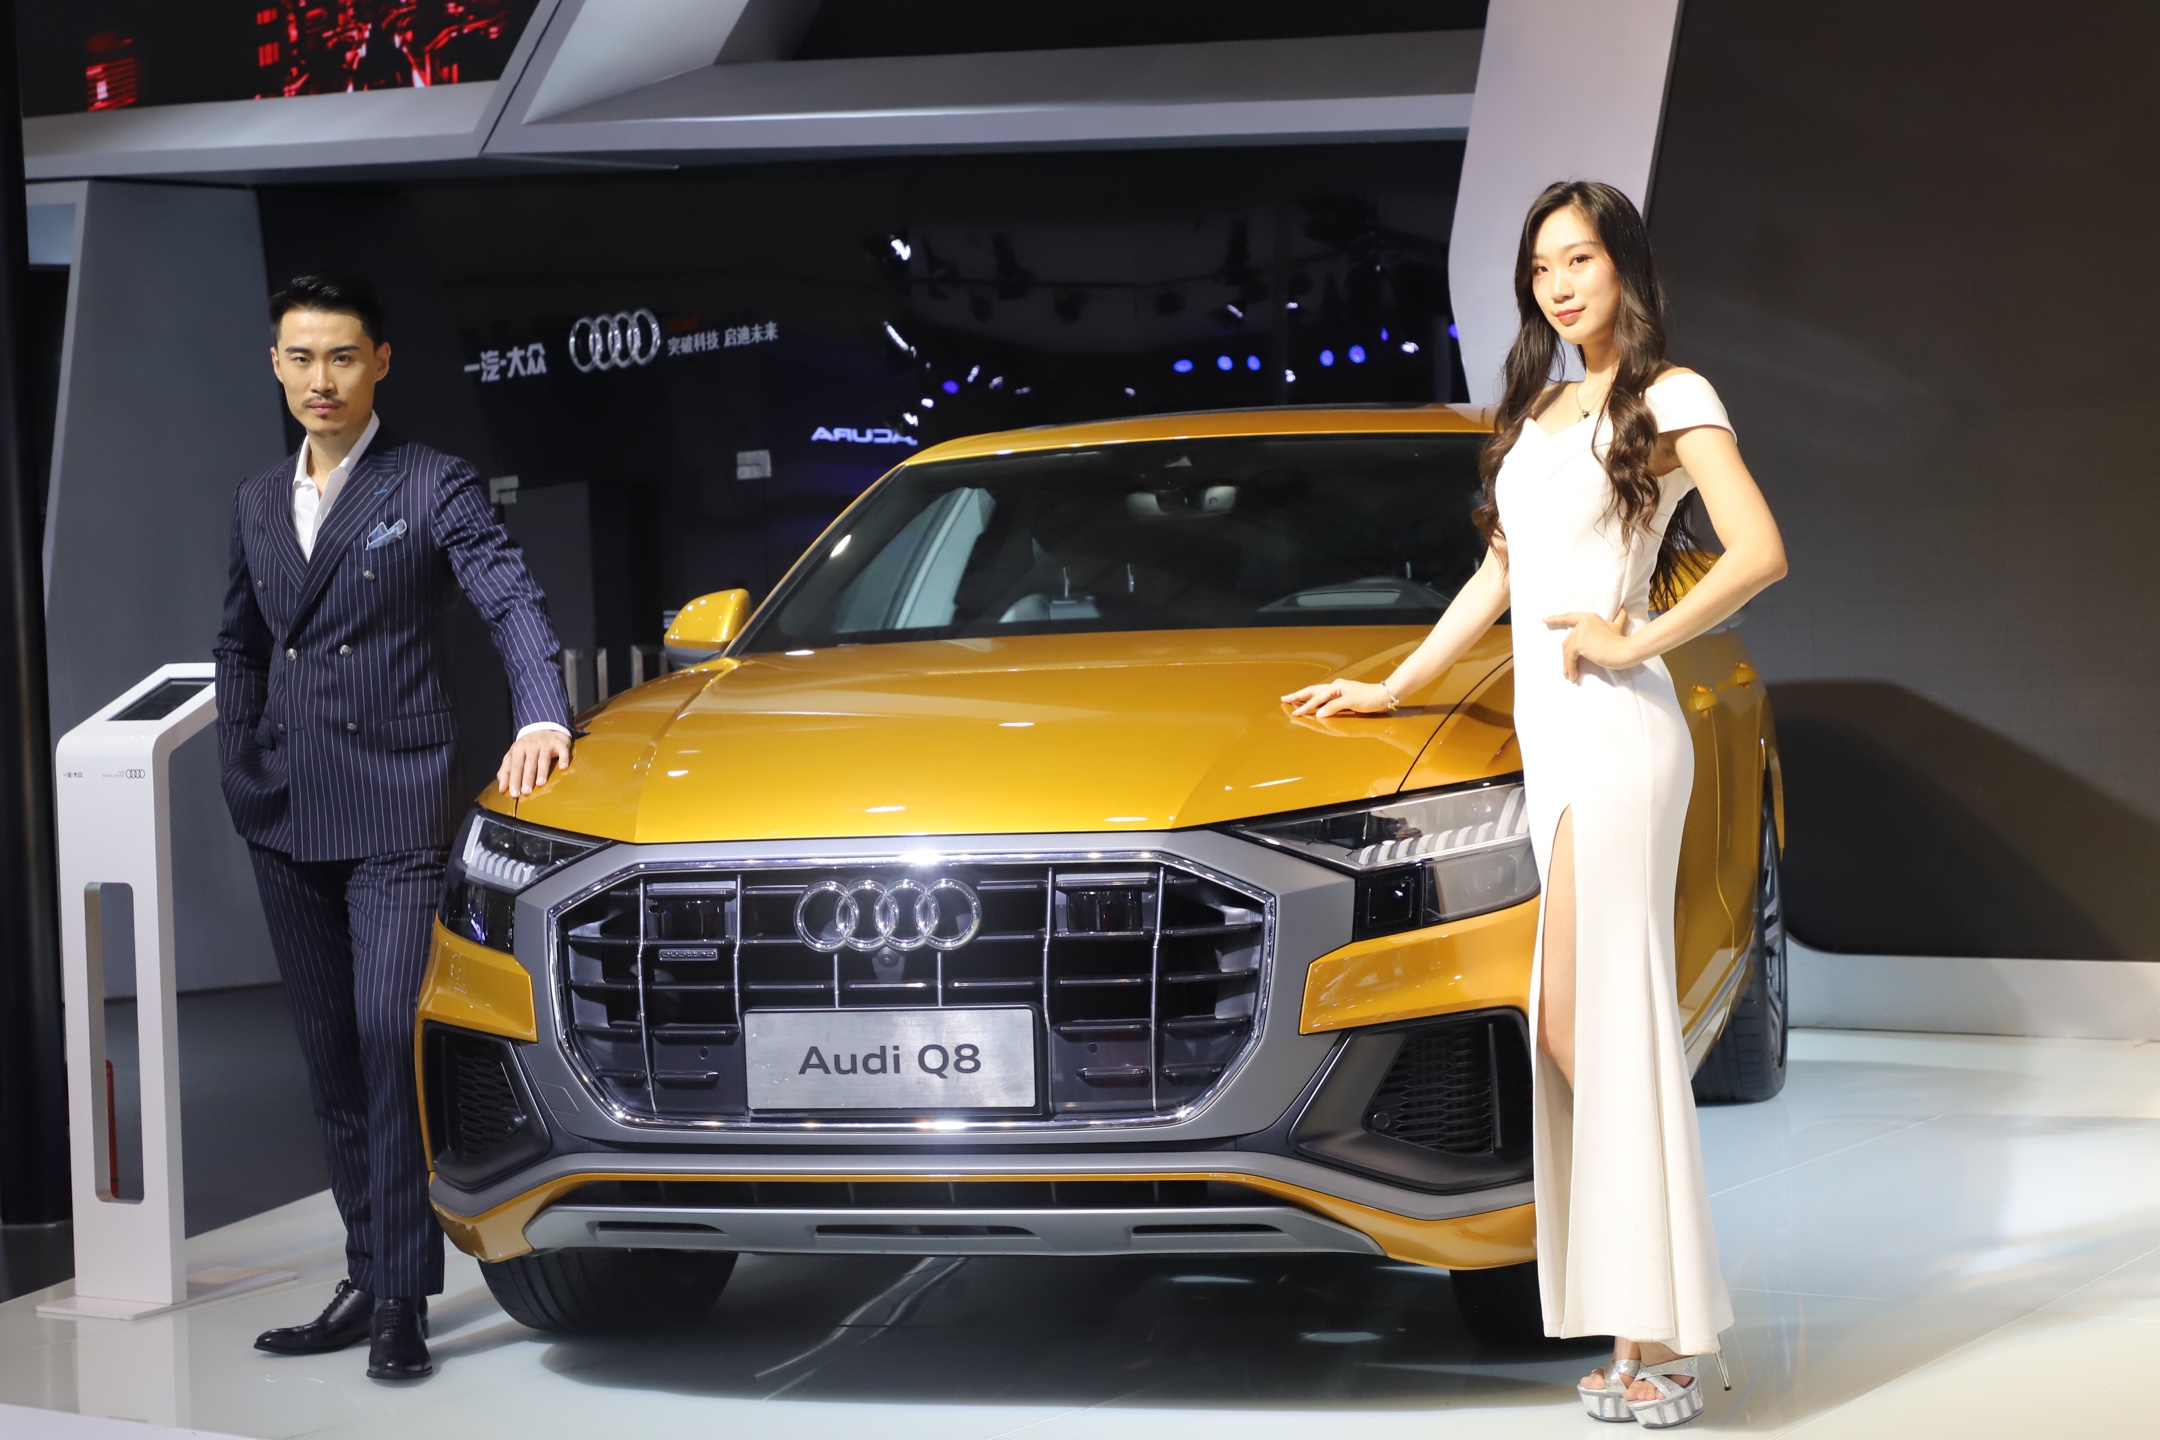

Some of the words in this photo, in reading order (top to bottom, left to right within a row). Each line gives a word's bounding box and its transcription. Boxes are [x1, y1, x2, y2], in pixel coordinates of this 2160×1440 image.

[667, 330, 720, 357] 突破科技
[724, 321, 778, 348] 启迪未来
[798, 1045, 901, 1075] Audi
[917, 1043, 982, 1079] Q8
